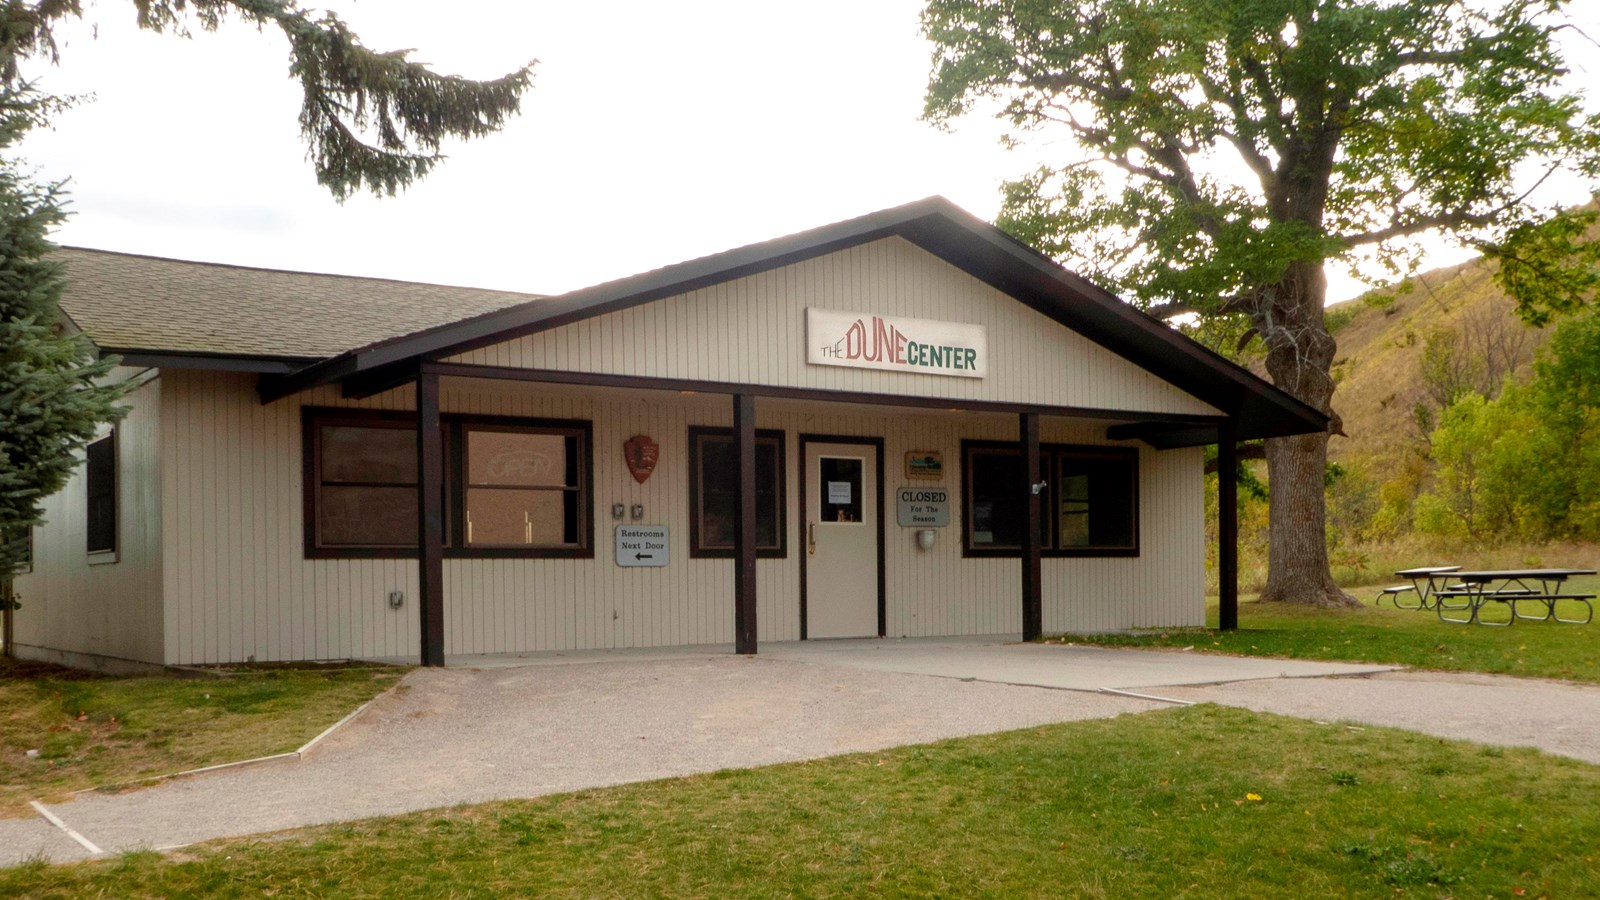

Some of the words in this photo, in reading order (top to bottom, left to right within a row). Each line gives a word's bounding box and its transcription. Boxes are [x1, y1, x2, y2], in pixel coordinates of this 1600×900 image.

[821, 337, 845, 359] THE
[845, 316, 908, 364] DUNE
[907, 341, 977, 370] CENTER
[901, 491, 946, 502] CLOSED
[910, 505, 922, 513] For
[925, 505, 938, 513] The
[621, 529, 665, 537] Restrooms
[621, 541, 641, 549] Next
[645, 541, 665, 549] Door
